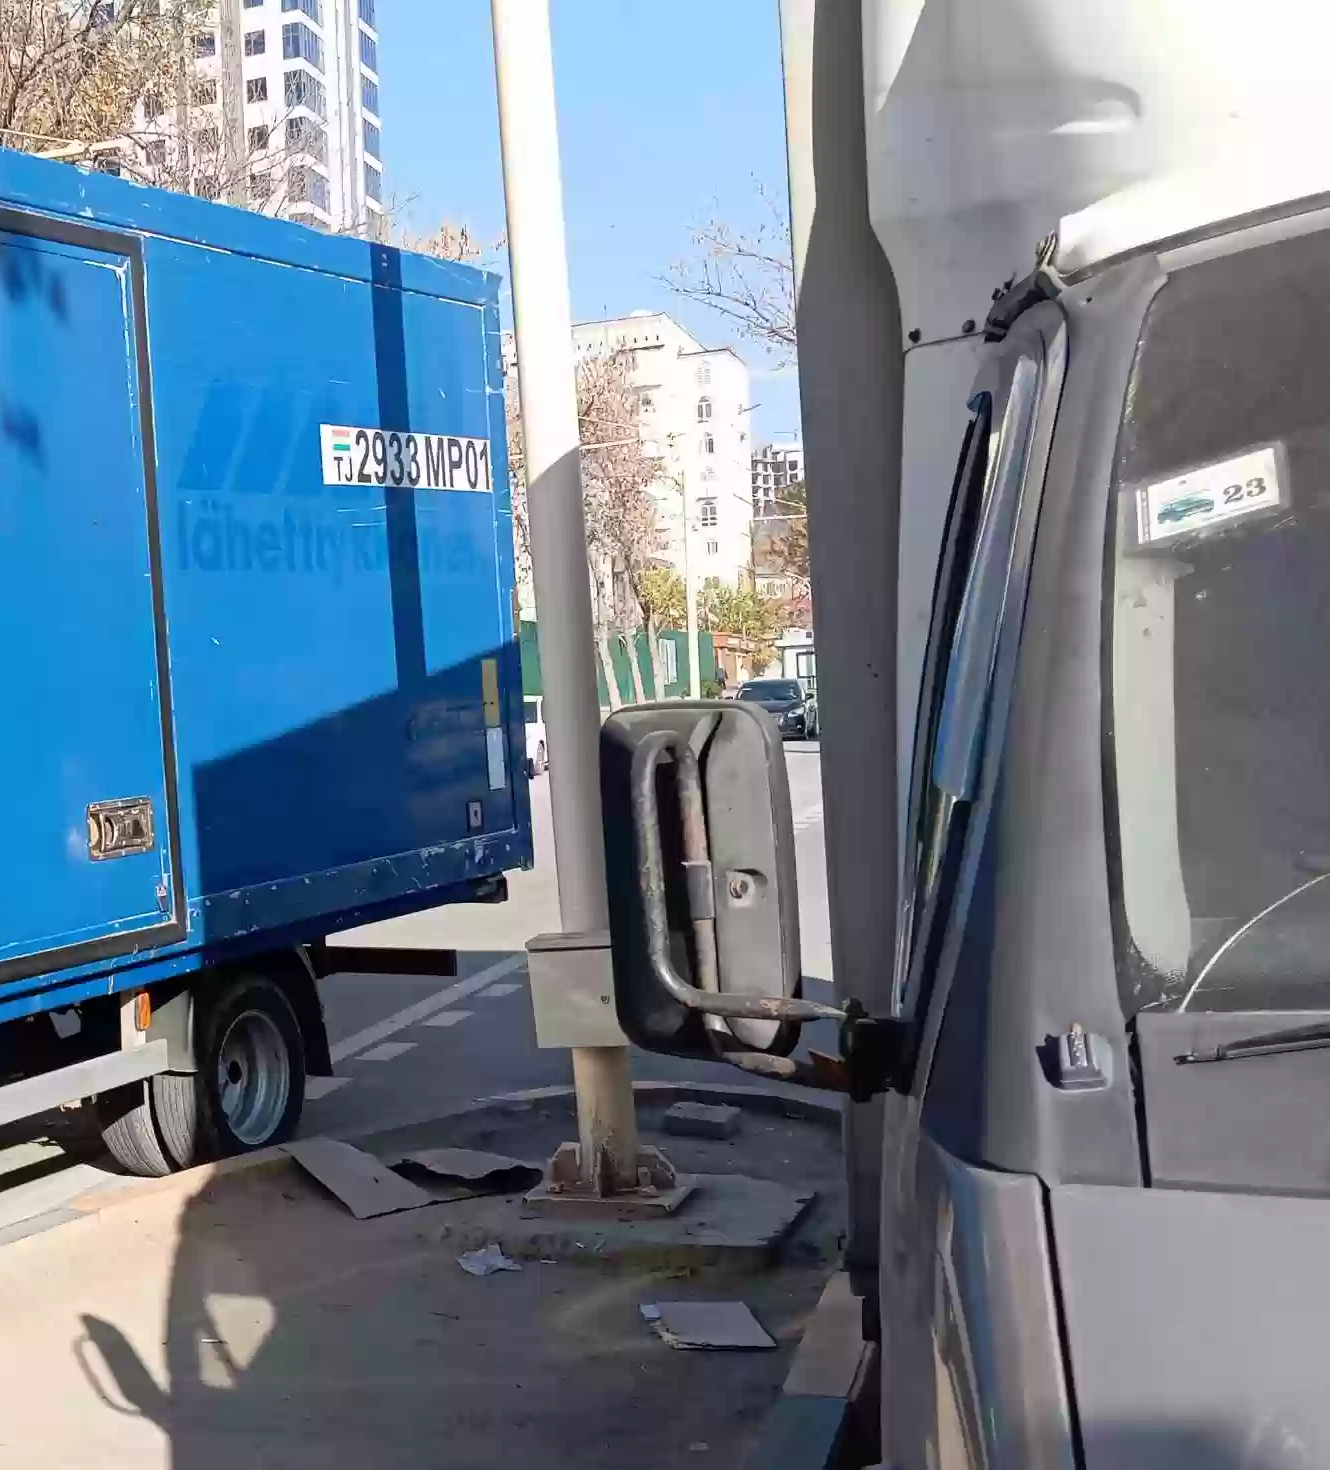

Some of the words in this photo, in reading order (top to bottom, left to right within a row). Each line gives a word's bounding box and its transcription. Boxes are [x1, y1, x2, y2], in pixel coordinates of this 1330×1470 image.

[333, 456, 353, 482] TJ
[355, 429, 421, 486] 2933
[1222, 476, 1267, 505] 23
